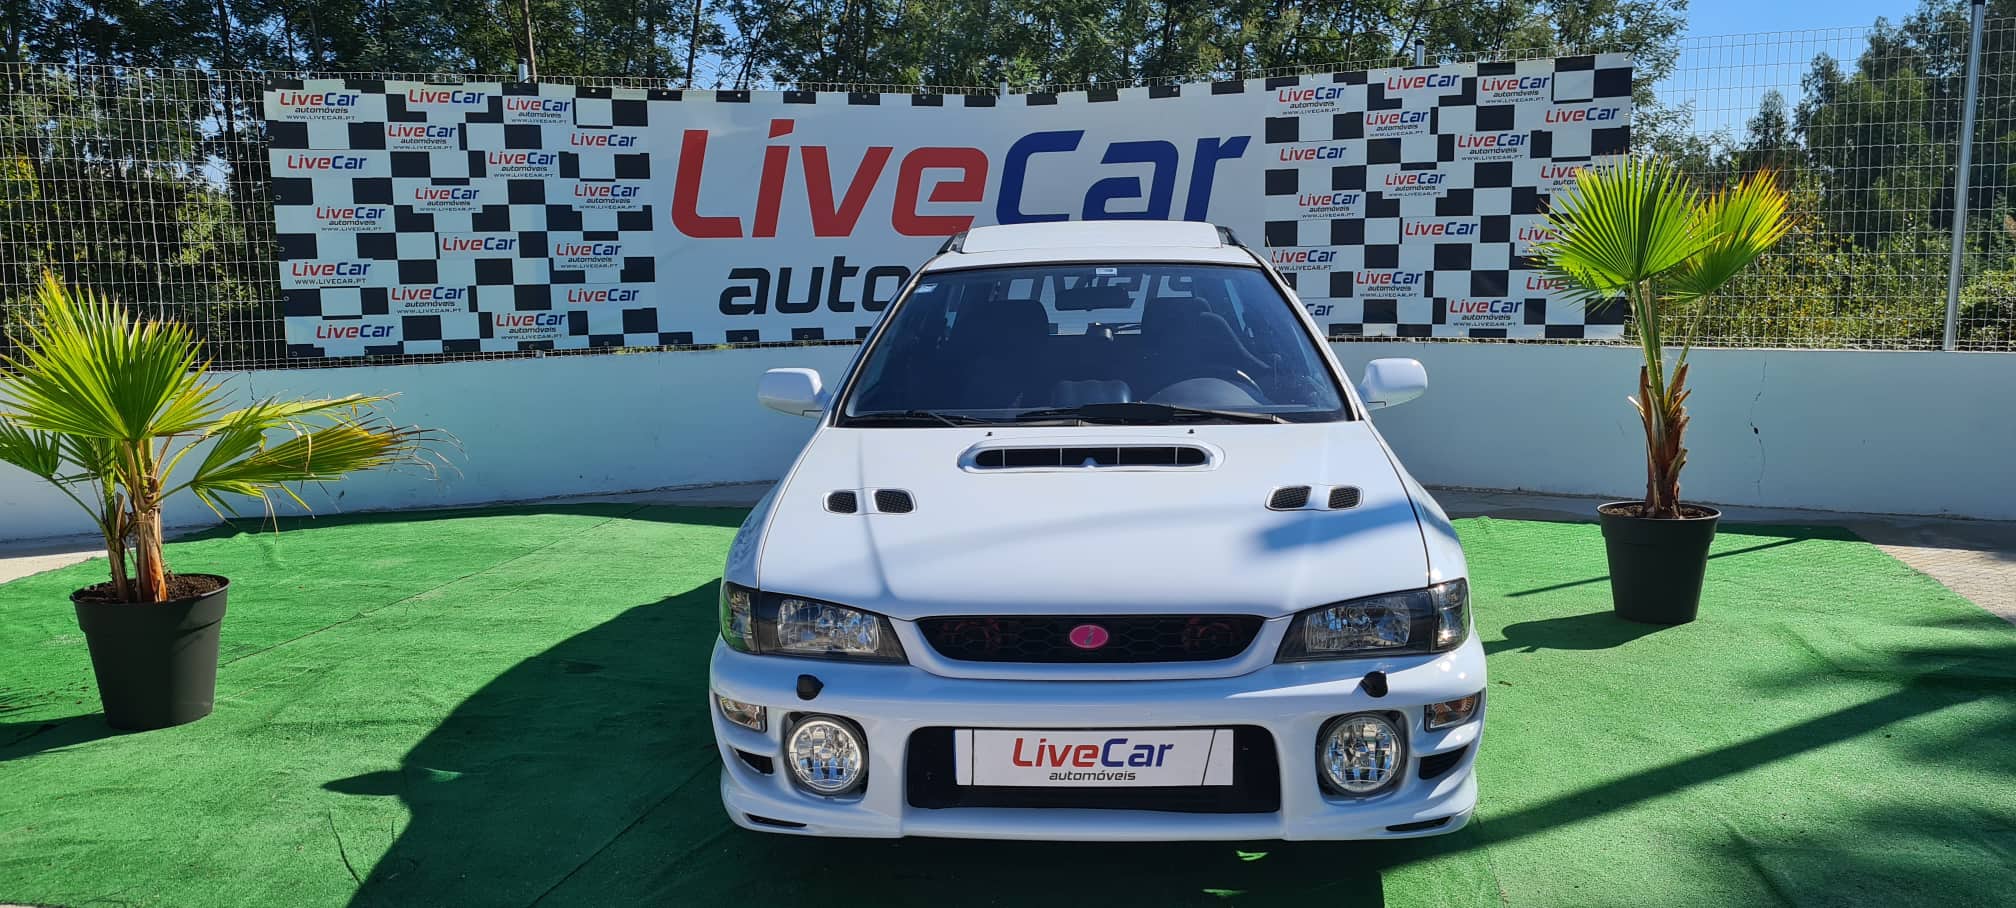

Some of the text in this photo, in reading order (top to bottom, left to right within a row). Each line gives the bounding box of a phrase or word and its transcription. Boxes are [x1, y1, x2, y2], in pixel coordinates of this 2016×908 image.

[1388, 74, 1460, 90] LiveCar
[1482, 77, 1549, 92] LiveCar
[280, 92, 360, 106] LiveCar
[408, 88, 485, 104] LiveCar
[1279, 86, 1344, 102] LiveCar
[507, 98, 571, 112] LiveCar
[1366, 111, 1429, 125] LiveCar
[1545, 107, 1620, 123] LiveCar
[388, 124, 456, 138] LiveCar
[571, 132, 638, 147] LiveCar
[1458, 134, 1529, 148] LiveCar
[489, 152, 557, 166] LiveCar
[1280, 146, 1347, 162] LiveCar
[288, 154, 367, 170] LiveCar
[671, 118, 1252, 238] LiveCar
[1385, 172, 1446, 186] LiveCar
[416, 187, 480, 200] LiveCar
[575, 184, 640, 198] LiveCar
[1299, 192, 1360, 206] LiveCar
[316, 206, 386, 220] LiveCar
[1405, 221, 1478, 236] LiveCar
[442, 236, 516, 251] LiveCar
[556, 242, 622, 256] LiveCar
[1271, 249, 1338, 263] LiveCar
[292, 261, 371, 276] LiveCar
[1356, 270, 1423, 284] LiveCar
[391, 286, 466, 300] LiveCar
[568, 288, 640, 303] LiveCar
[1450, 298, 1522, 314] LiveCar
[496, 312, 566, 327] LiveCar
[316, 324, 395, 340] LiveCar
[1012, 738, 1174, 768] LiveCar
[1048, 769, 1137, 782] automóveis
